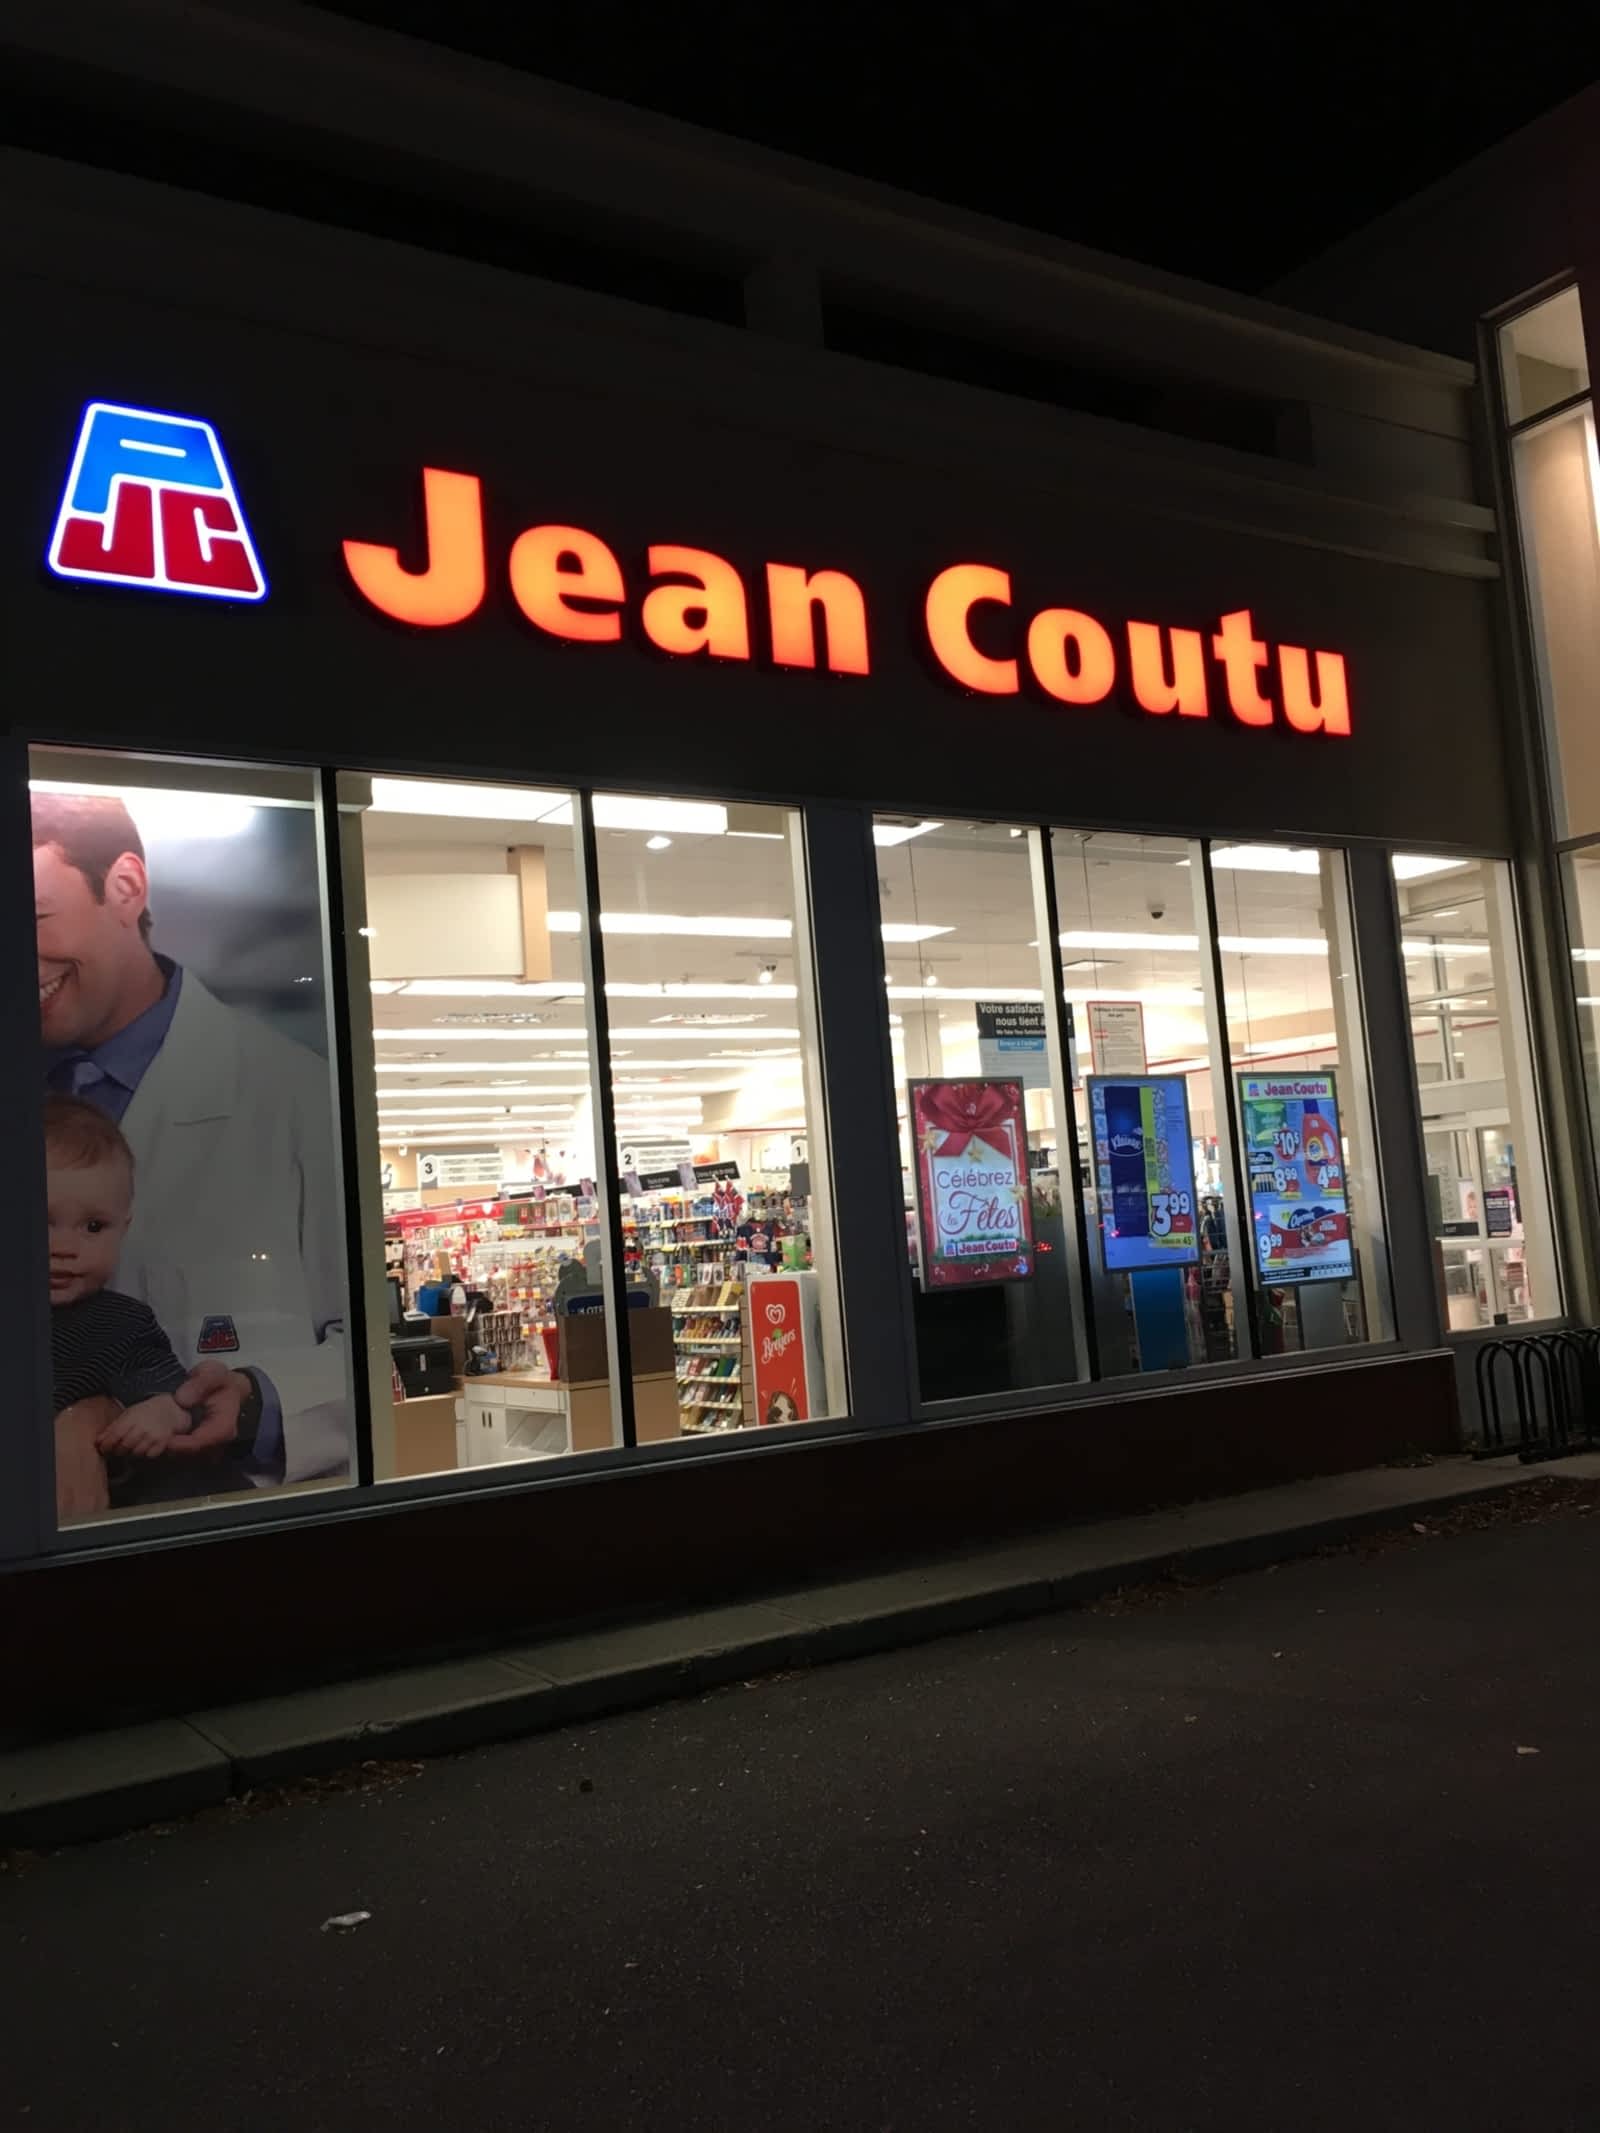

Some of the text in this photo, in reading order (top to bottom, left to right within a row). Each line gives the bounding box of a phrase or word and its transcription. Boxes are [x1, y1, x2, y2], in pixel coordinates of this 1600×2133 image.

[342, 466, 1351, 736] Jean Coutu
[979, 1003, 1044, 1015] Votre satisfacti
[995, 1017, 1017, 1026] nous
[1018, 1015, 1039, 1026] tient
[796, 1146, 801, 1157] 1
[624, 1154, 632, 1165] 2
[424, 1162, 433, 1175] 3
[937, 1167, 1014, 1189] Célébrez
[939, 1190, 1019, 1236] Fêtes
[761, 1329, 796, 1364] Breyers
